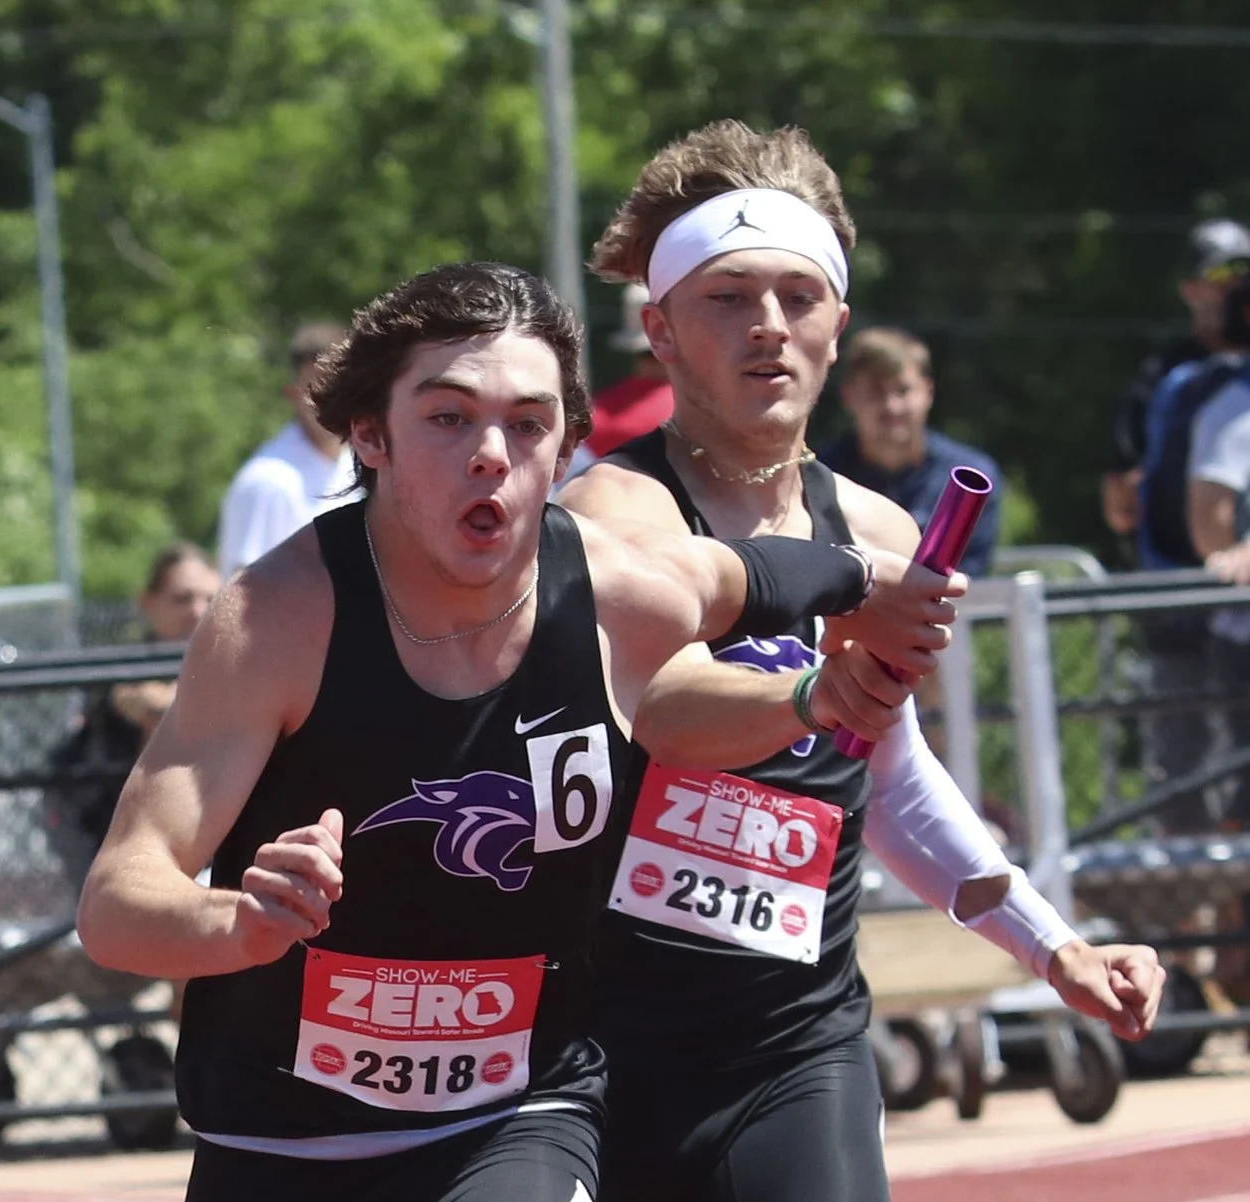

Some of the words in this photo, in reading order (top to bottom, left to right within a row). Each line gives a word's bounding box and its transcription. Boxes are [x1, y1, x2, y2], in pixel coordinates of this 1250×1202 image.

[552, 736, 598, 842] 6
[710, 780, 794, 817] SHOW-ME
[656, 784, 817, 868] ZERO
[665, 869, 775, 932] 2316
[327, 975, 515, 1028] ZERO
[376, 967, 477, 984] SHOW-ME
[350, 1050, 477, 1095] 2318
